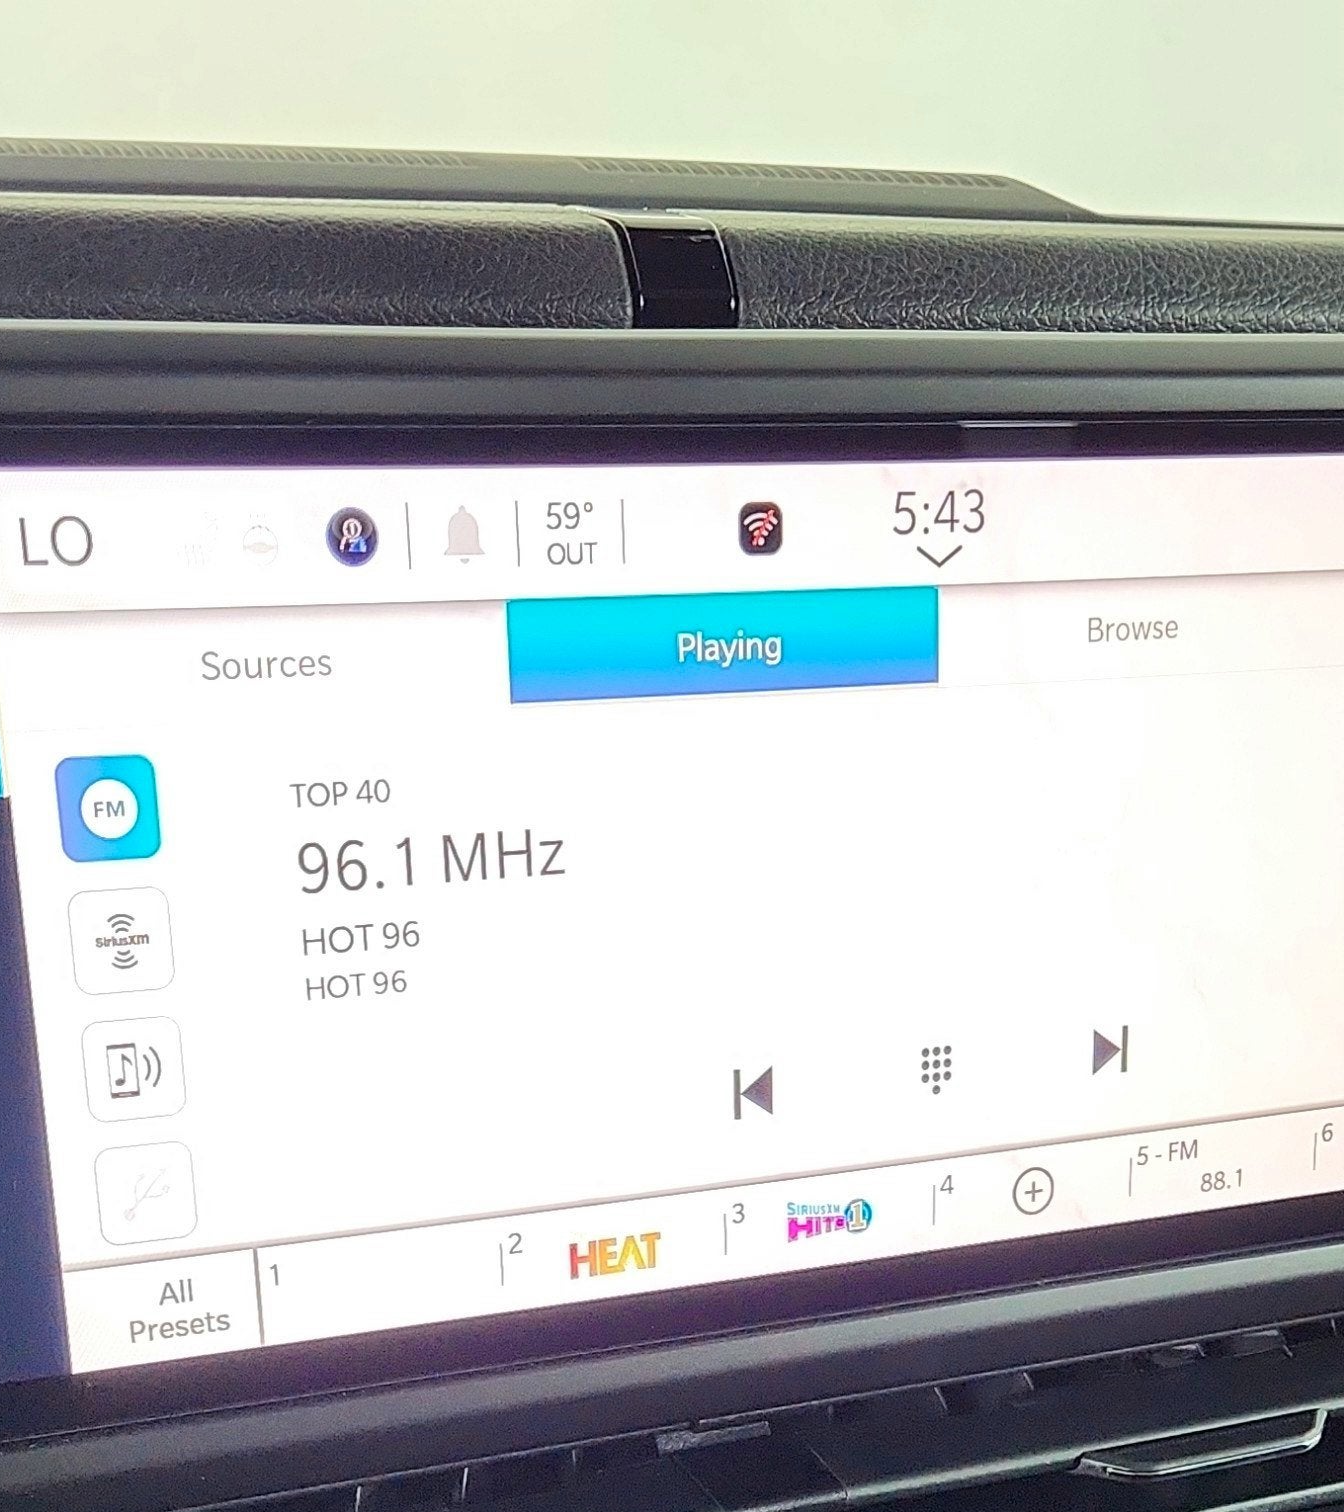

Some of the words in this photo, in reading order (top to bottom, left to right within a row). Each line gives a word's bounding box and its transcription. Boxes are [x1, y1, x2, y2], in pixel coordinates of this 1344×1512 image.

[545, 500, 594, 531] 59°
[891, 488, 986, 536] 5:43
[17, 515, 94, 567] LO
[546, 541, 598, 566] OUT
[1087, 615, 1179, 644] Browse
[676, 630, 783, 668] Playing
[200, 650, 333, 682] Sources
[289, 780, 348, 808] TOP
[356, 778, 391, 804] 40
[93, 800, 126, 818] FM
[297, 836, 414, 894] 96.1
[442, 828, 566, 883] MHz
[302, 923, 374, 956] HOT
[382, 920, 420, 949] 96
[306, 972, 366, 1000] HOT
[372, 969, 408, 995] 96
[1322, 1122, 1334, 1142] 6
[1137, 1146, 1149, 1166] 5
[1168, 1140, 1199, 1163] FM
[939, 1175, 954, 1196] 4
[1200, 1168, 1244, 1192] 88.1
[732, 1203, 746, 1225] 3
[508, 1234, 523, 1255] 2
[568, 1231, 661, 1280] HEAT
[269, 1263, 280, 1287] 1
[158, 1277, 194, 1306] All
[128, 1310, 232, 1344] Presets
